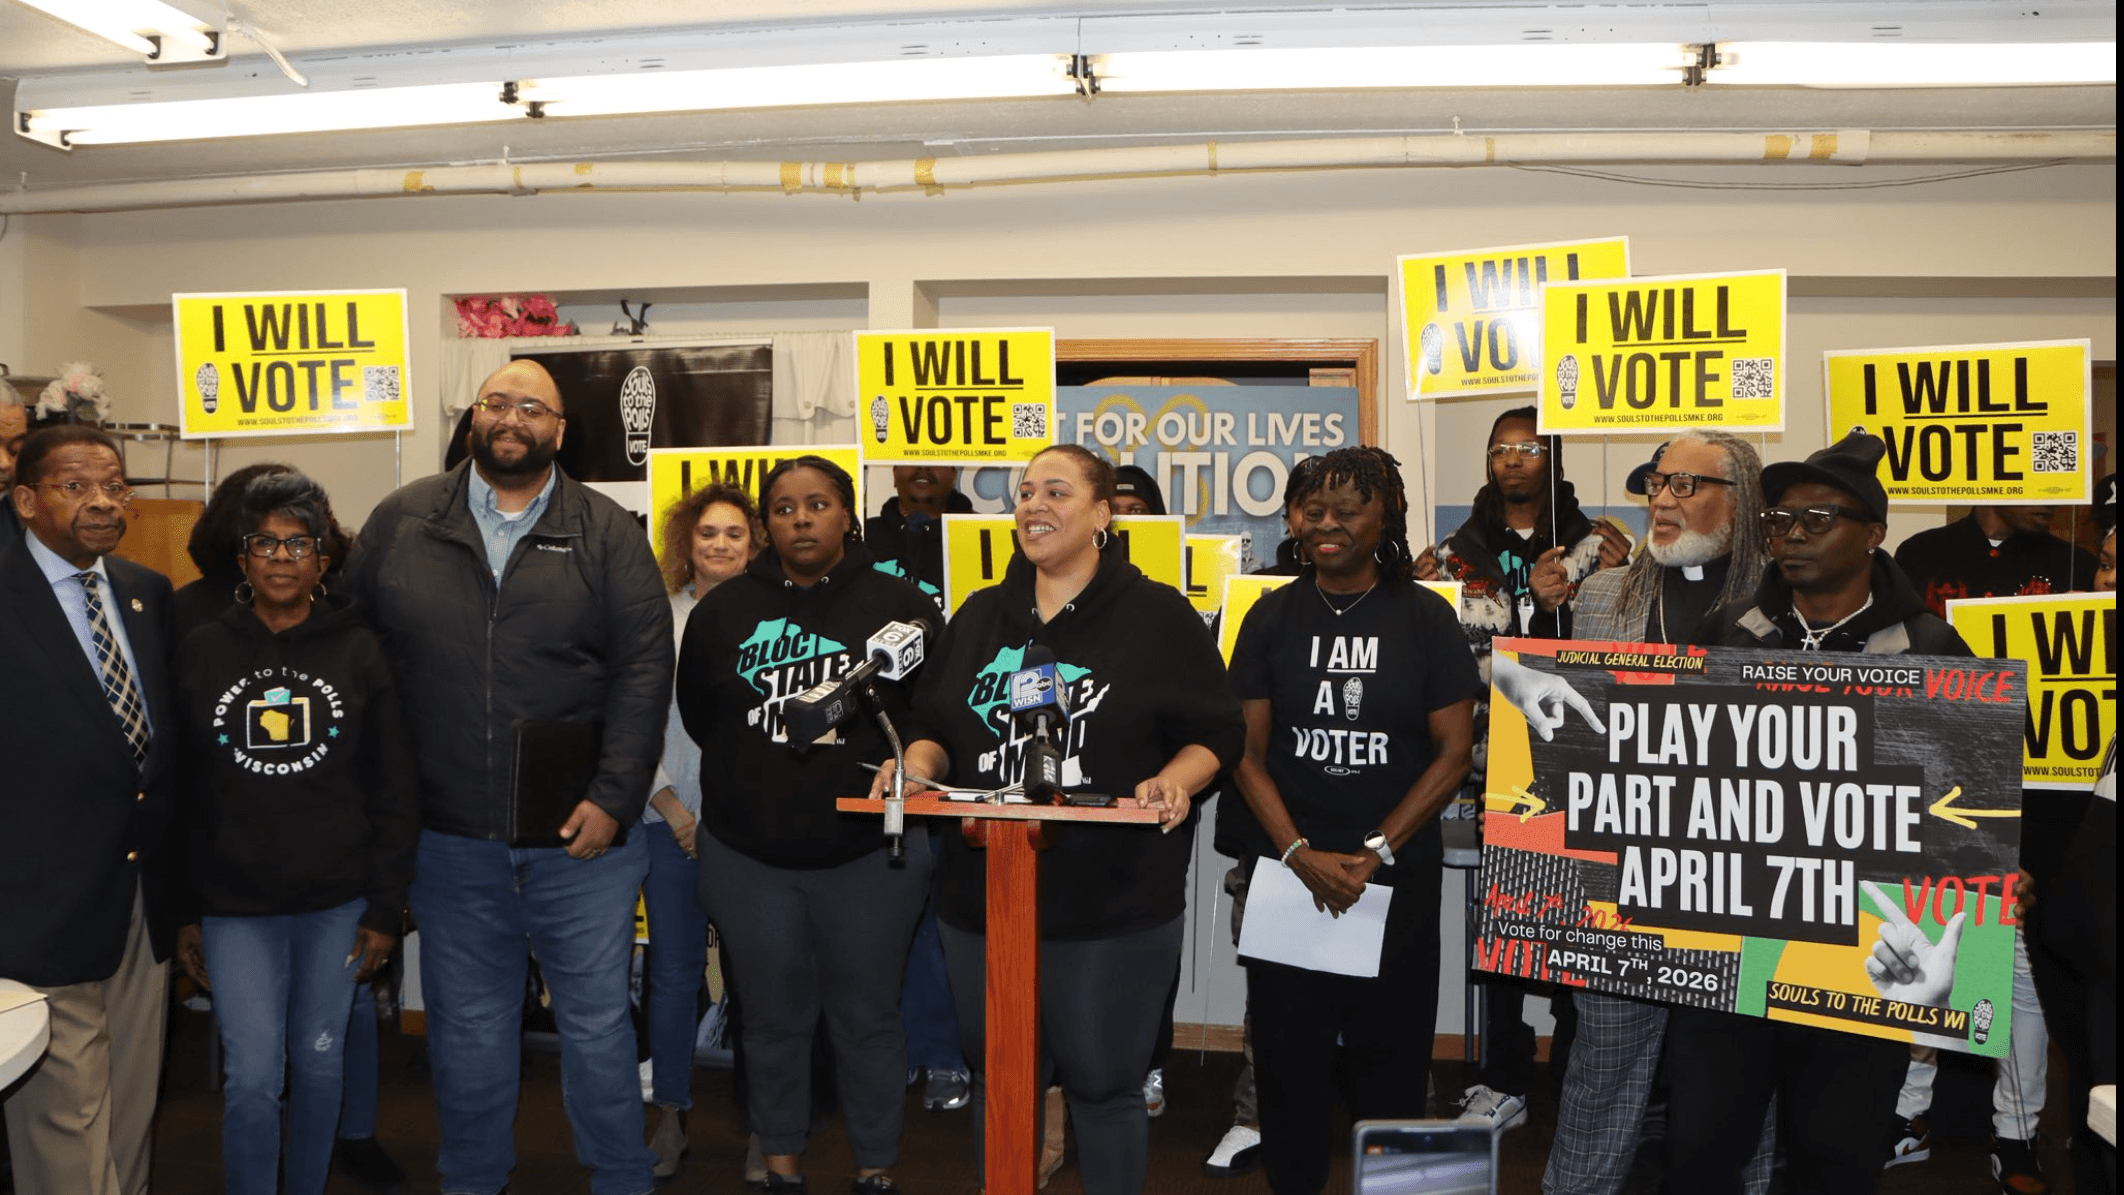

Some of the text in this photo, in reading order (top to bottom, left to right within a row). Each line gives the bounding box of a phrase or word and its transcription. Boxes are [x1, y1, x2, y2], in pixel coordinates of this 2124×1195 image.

[1435, 264, 1447, 312] I
[213, 302, 375, 352] I WILL
[1576, 286, 1747, 344] I WILL
[884, 340, 1023, 386] I WILL
[1592, 351, 1724, 409] VOTE
[231, 359, 358, 413] VOTE
[1864, 357, 2048, 415] I WILL
[899, 396, 1006, 445] VOTE
[1077, 412, 1149, 446] FOR
[1157, 412, 1237, 446] OUR
[1248, 412, 1345, 447] LIVES
[1594, 413, 1723, 423] WWW.SOULSTOTHEPOLLSMKE.ORG
[629, 440, 647, 453] VOTE
[1883, 424, 2023, 481] VOTE
[1887, 486, 2024, 495] WWW.SOULSTOTHEPOLLSMKE.ORG
[979, 528, 993, 580] I
[1309, 636, 1379, 669] I AM
[1557, 650, 1704, 670] JUDICIAL GENERAL ELECTION
[255, 668, 273, 679] to
[312, 678, 344, 719] POLLS
[970, 671, 1010, 707] BL
[1036, 679, 1052, 689] abc
[1743, 665, 1797, 681] RAISE
[1803, 667, 1852, 682] YOUR
[1858, 668, 1920, 685] VOICE
[1926, 669, 2016, 703] VOICE
[748, 706, 762, 727] OF
[1013, 694, 1041, 707] WISN
[1313, 680, 1335, 716] A
[1292, 726, 1389, 765] VOTER
[1609, 702, 1858, 772] PLAY YOUR
[233, 743, 329, 775] WISCONSIN
[978, 750, 997, 773] OF
[1567, 772, 1921, 853] PART AND VOTE
[1618, 846, 1854, 926] APRIL 7TH
[1498, 920, 1662, 951] Vote for change this
[1547, 949, 1612, 975] APRIL
[1657, 966, 1718, 992] 2026
[1769, 982, 1966, 1031] SOULS TO THE POLLS WI
